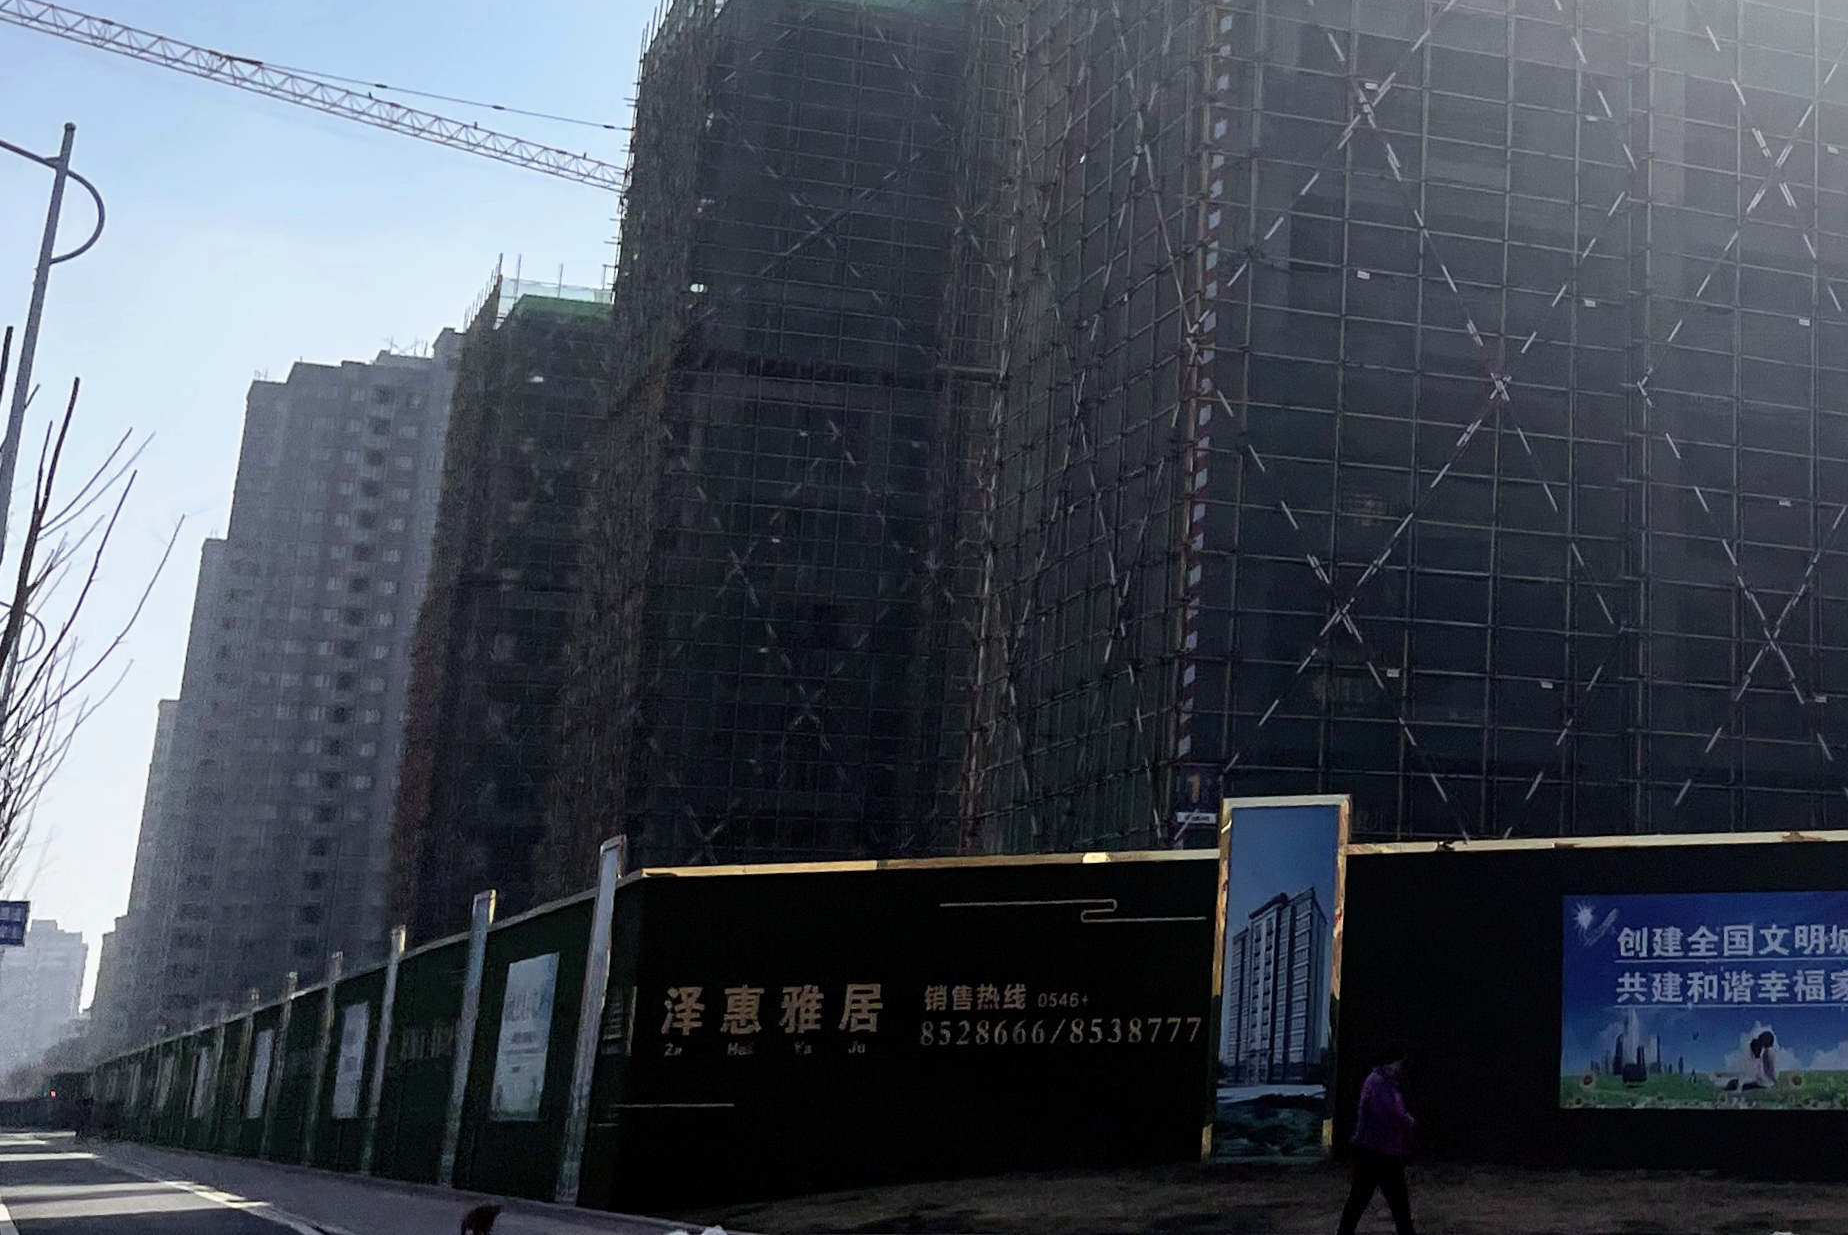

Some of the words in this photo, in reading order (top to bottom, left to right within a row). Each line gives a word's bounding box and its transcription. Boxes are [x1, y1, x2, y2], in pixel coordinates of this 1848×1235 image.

[660, 983, 884, 1036] 泽惠雅居
[923, 983, 1027, 1012] 销售热线
[919, 1016, 1202, 1047] 8528666/8538777
